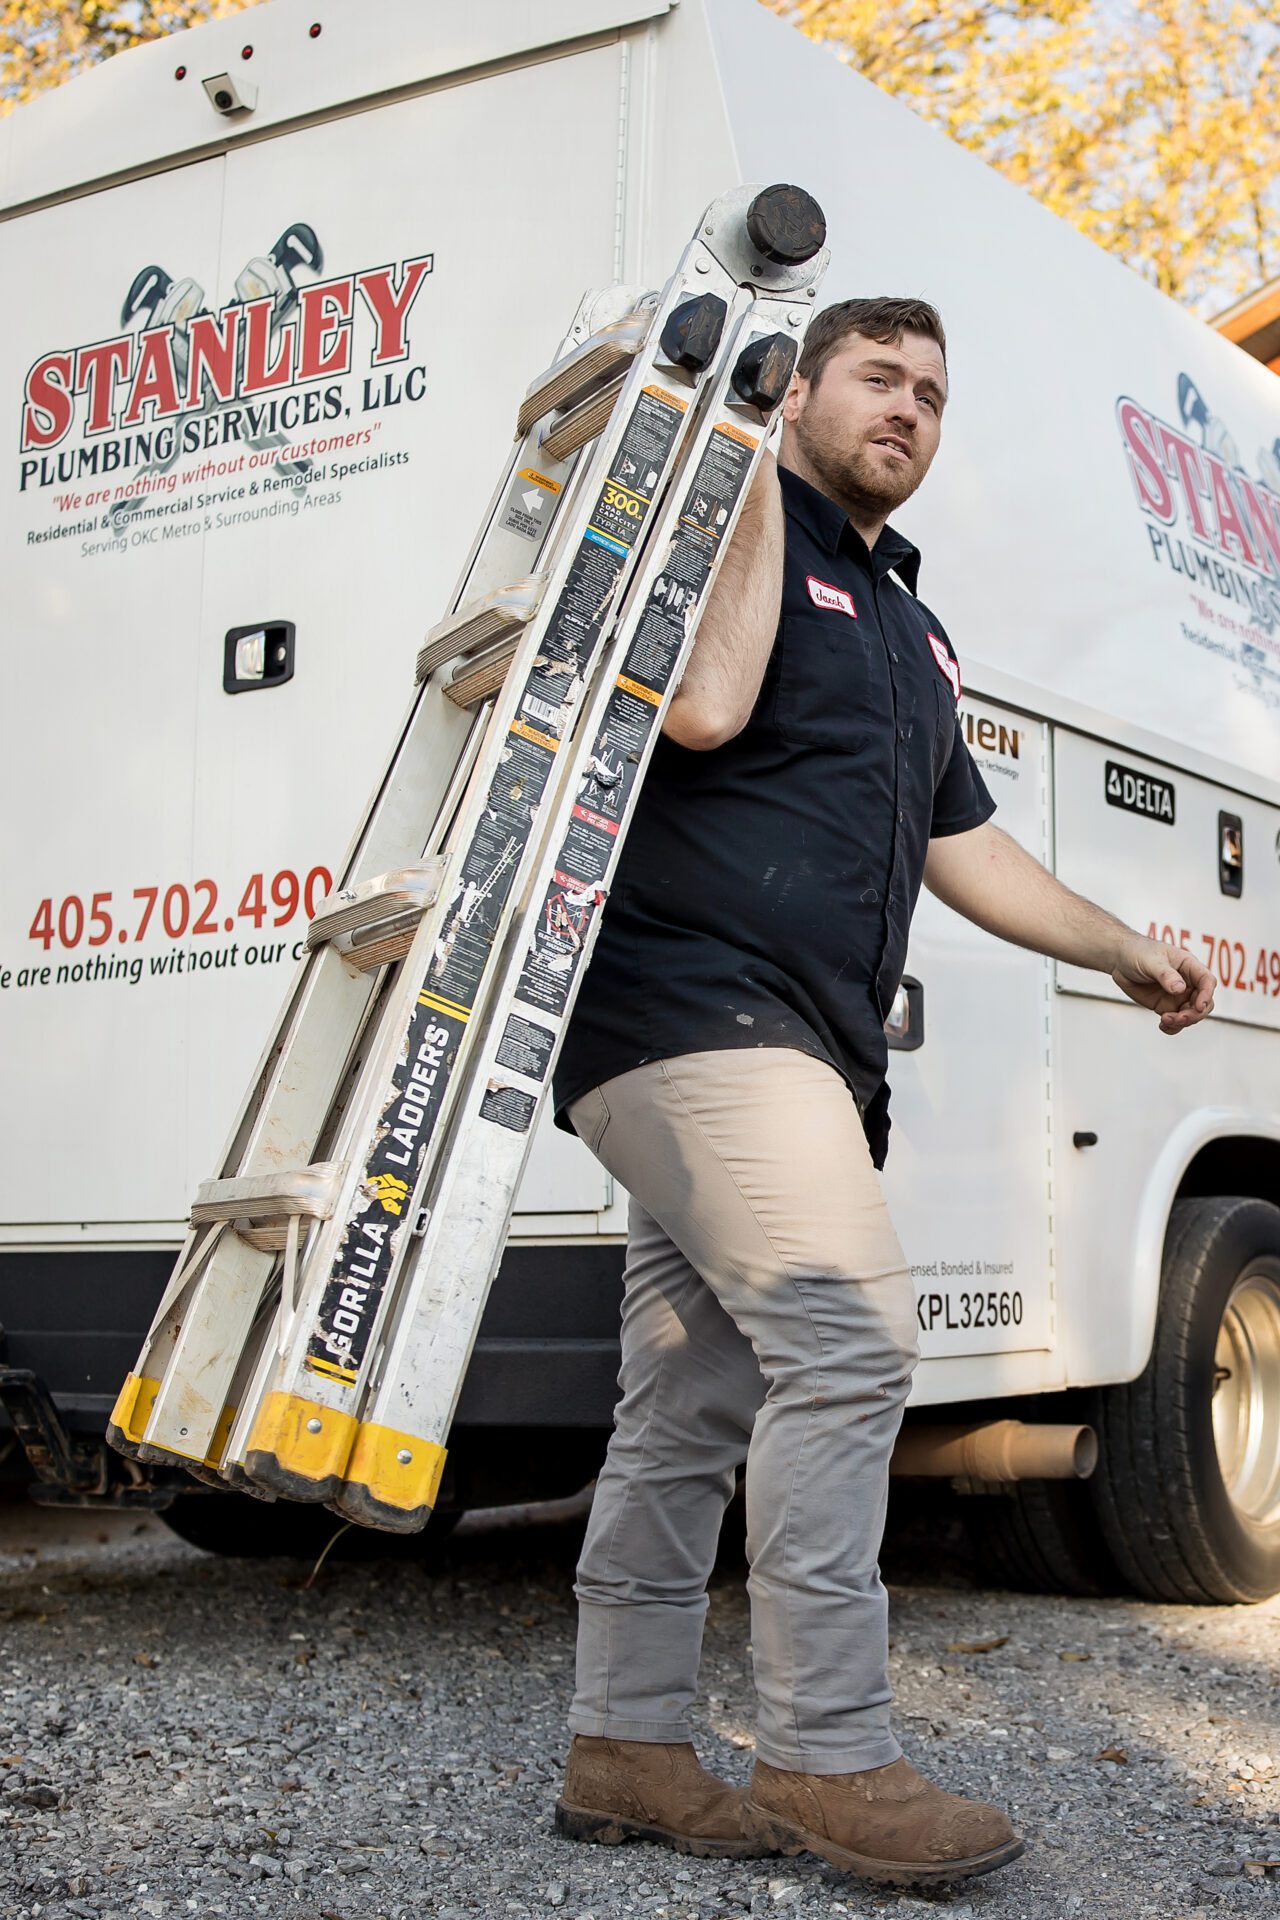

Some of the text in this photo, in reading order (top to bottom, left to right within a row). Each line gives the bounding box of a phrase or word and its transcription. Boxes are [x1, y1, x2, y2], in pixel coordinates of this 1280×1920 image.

[19, 253, 434, 453] STANLEY
[18, 366, 427, 492] PLUMBING SERVICES, LLC
[27, 450, 409, 546] Residential & Commercial Service & Remodel Specialists
[85, 489, 110, 507] are
[114, 473, 178, 501] nothing
[182, 457, 245, 487] without
[249, 450, 277, 470] our
[282, 422, 382, 463] customers"
[1115, 395, 1280, 582] STAN
[81, 536, 128, 558] Serving
[131, 527, 158, 546] OKC
[162, 520, 201, 541] Metro
[216, 498, 299, 529] Surrounding
[303, 489, 342, 510] Areas
[595, 515, 617, 531] TYPE
[599, 507, 637, 530] CAPACITY
[600, 502, 621, 516] LOAD
[603, 486, 640, 516] 300
[816, 590, 845, 610] Jacob
[1145, 523, 1273, 619] PLUMBING
[1123, 774, 1173, 819] DELTA
[28, 866, 334, 950] 405.702.490
[17, 967, 50, 988] are
[56, 952, 143, 984] nothing
[149, 941, 239, 975] without
[244, 941, 286, 966] our
[385, 1024, 450, 1166] LADDERS
[325, 1222, 389, 1358] GORILLA
[910, 1260, 1013, 1277] ensed, Bonded & Insured
[917, 1291, 1023, 1331] KPL32560
